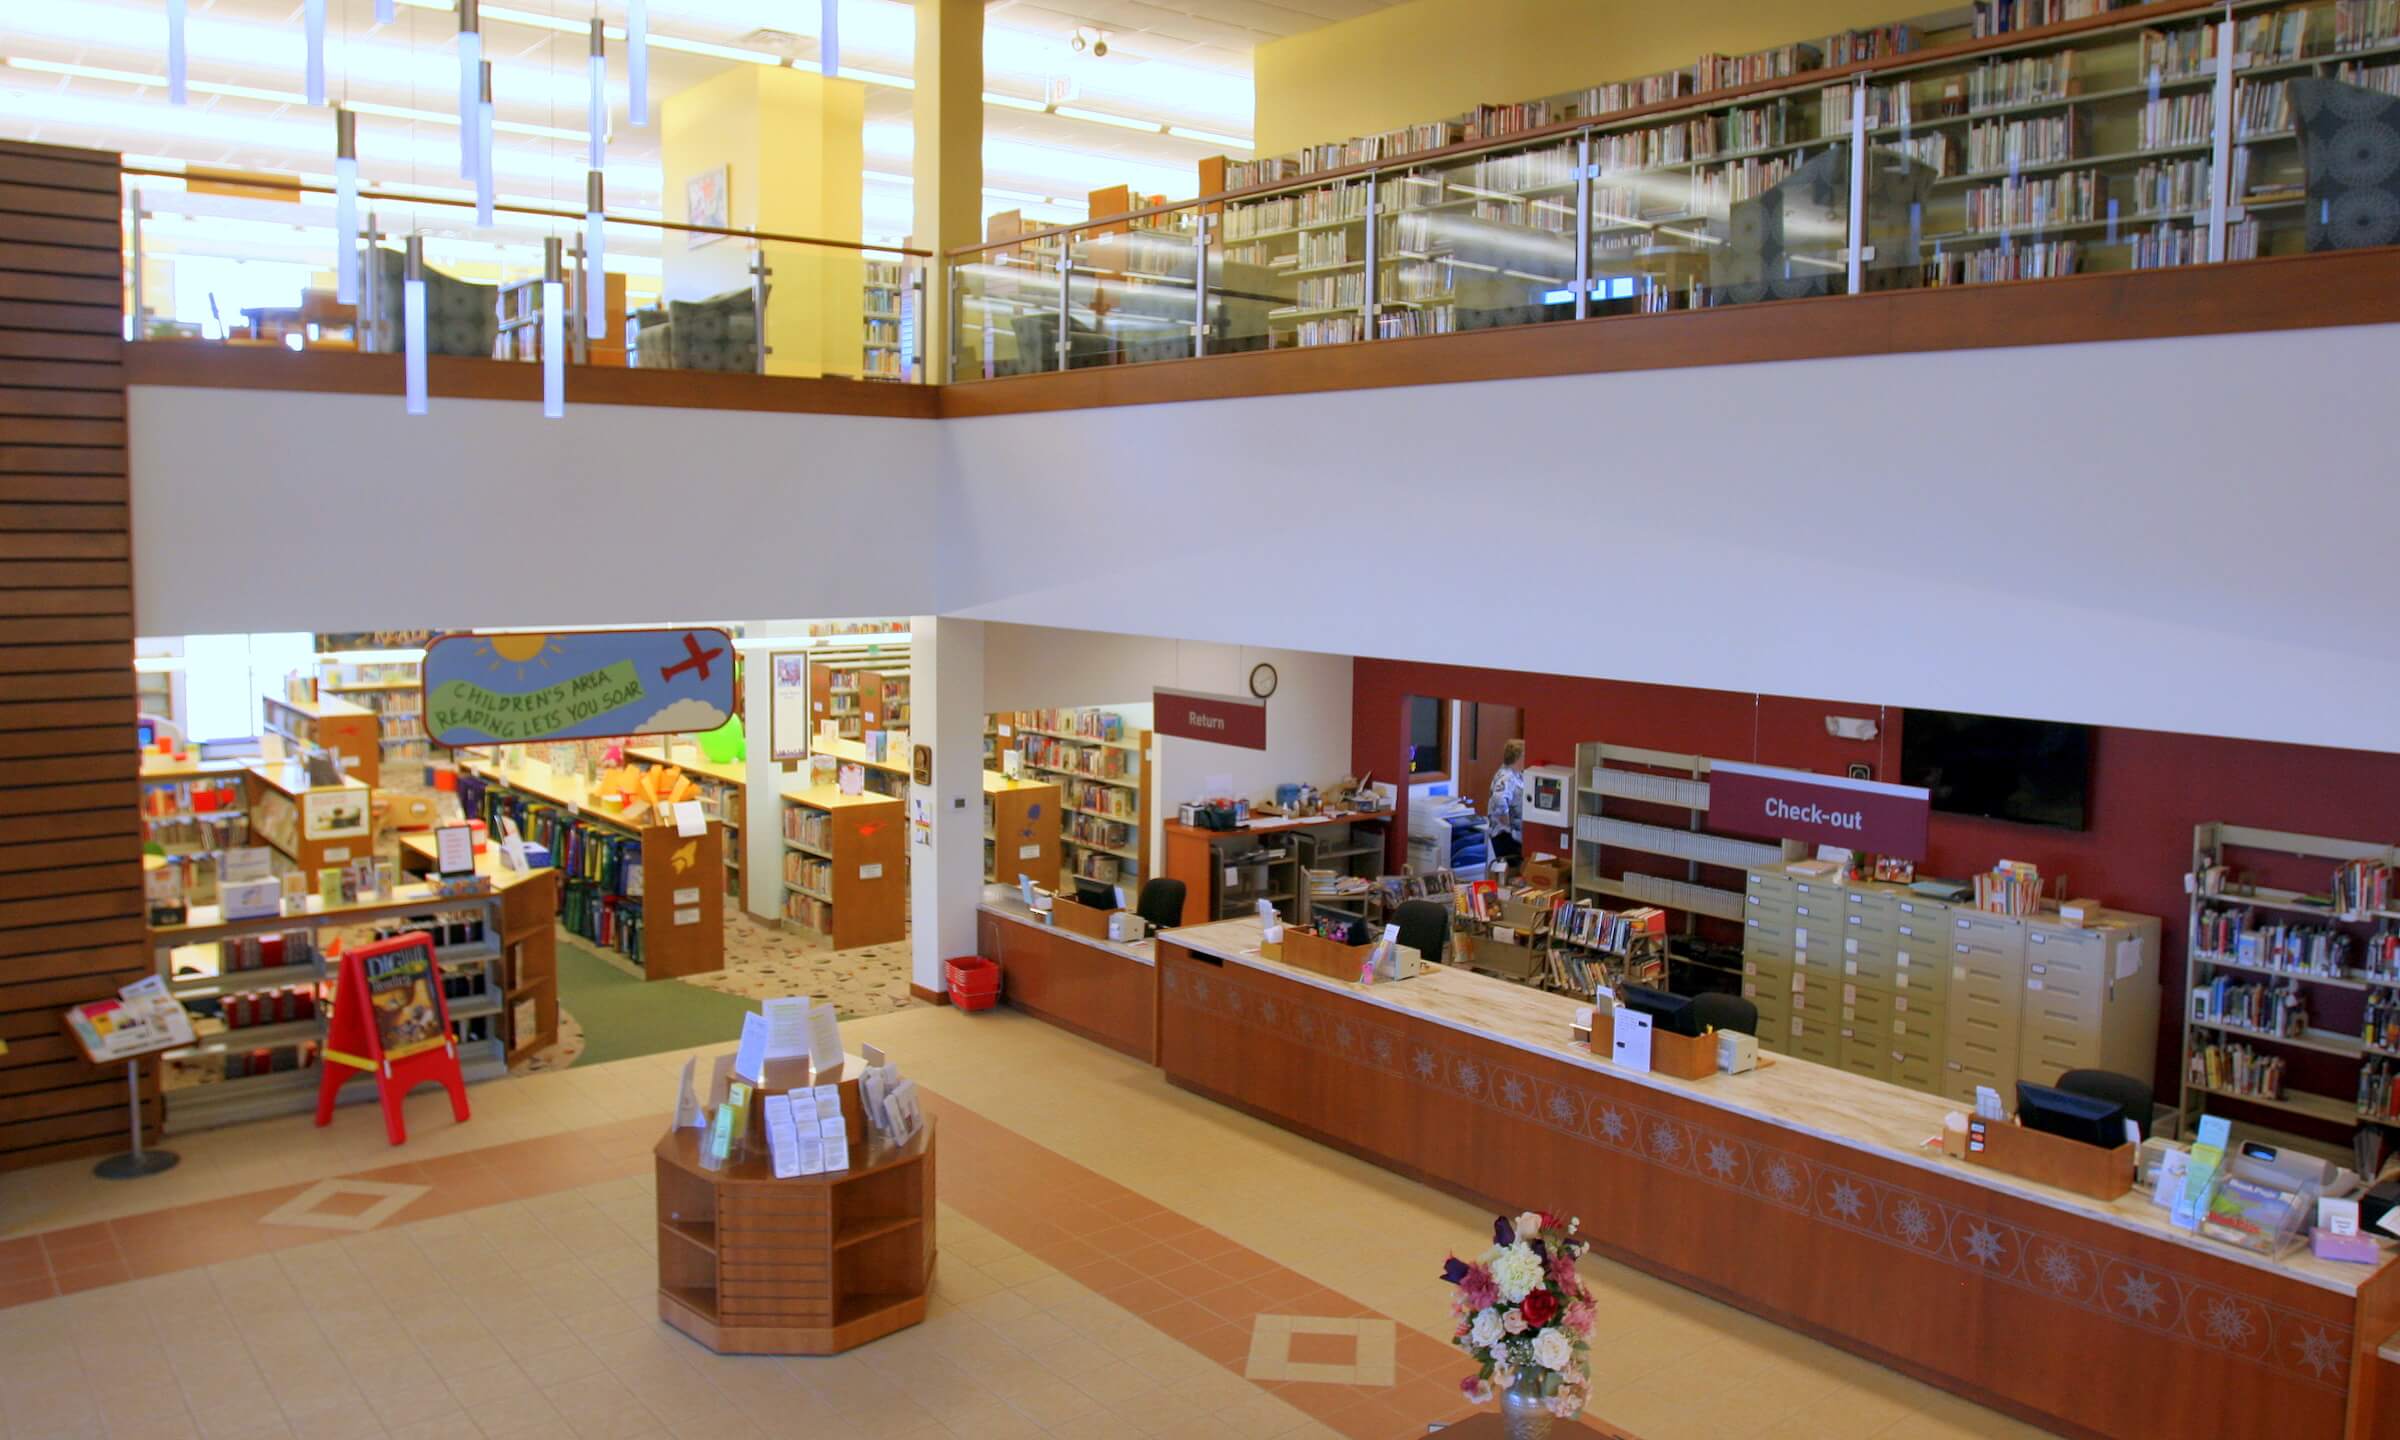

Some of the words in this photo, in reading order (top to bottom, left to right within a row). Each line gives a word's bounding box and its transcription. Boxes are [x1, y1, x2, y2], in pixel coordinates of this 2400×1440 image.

[436, 707, 513, 737] READING
[566, 699, 598, 720] YOU
[602, 681, 641, 710] SOAR
[454, 682, 565, 712] CHILDREN'S
[572, 670, 610, 696] AREA
[1188, 711, 1225, 730] Return
[1765, 797, 1862, 830] Check-out
